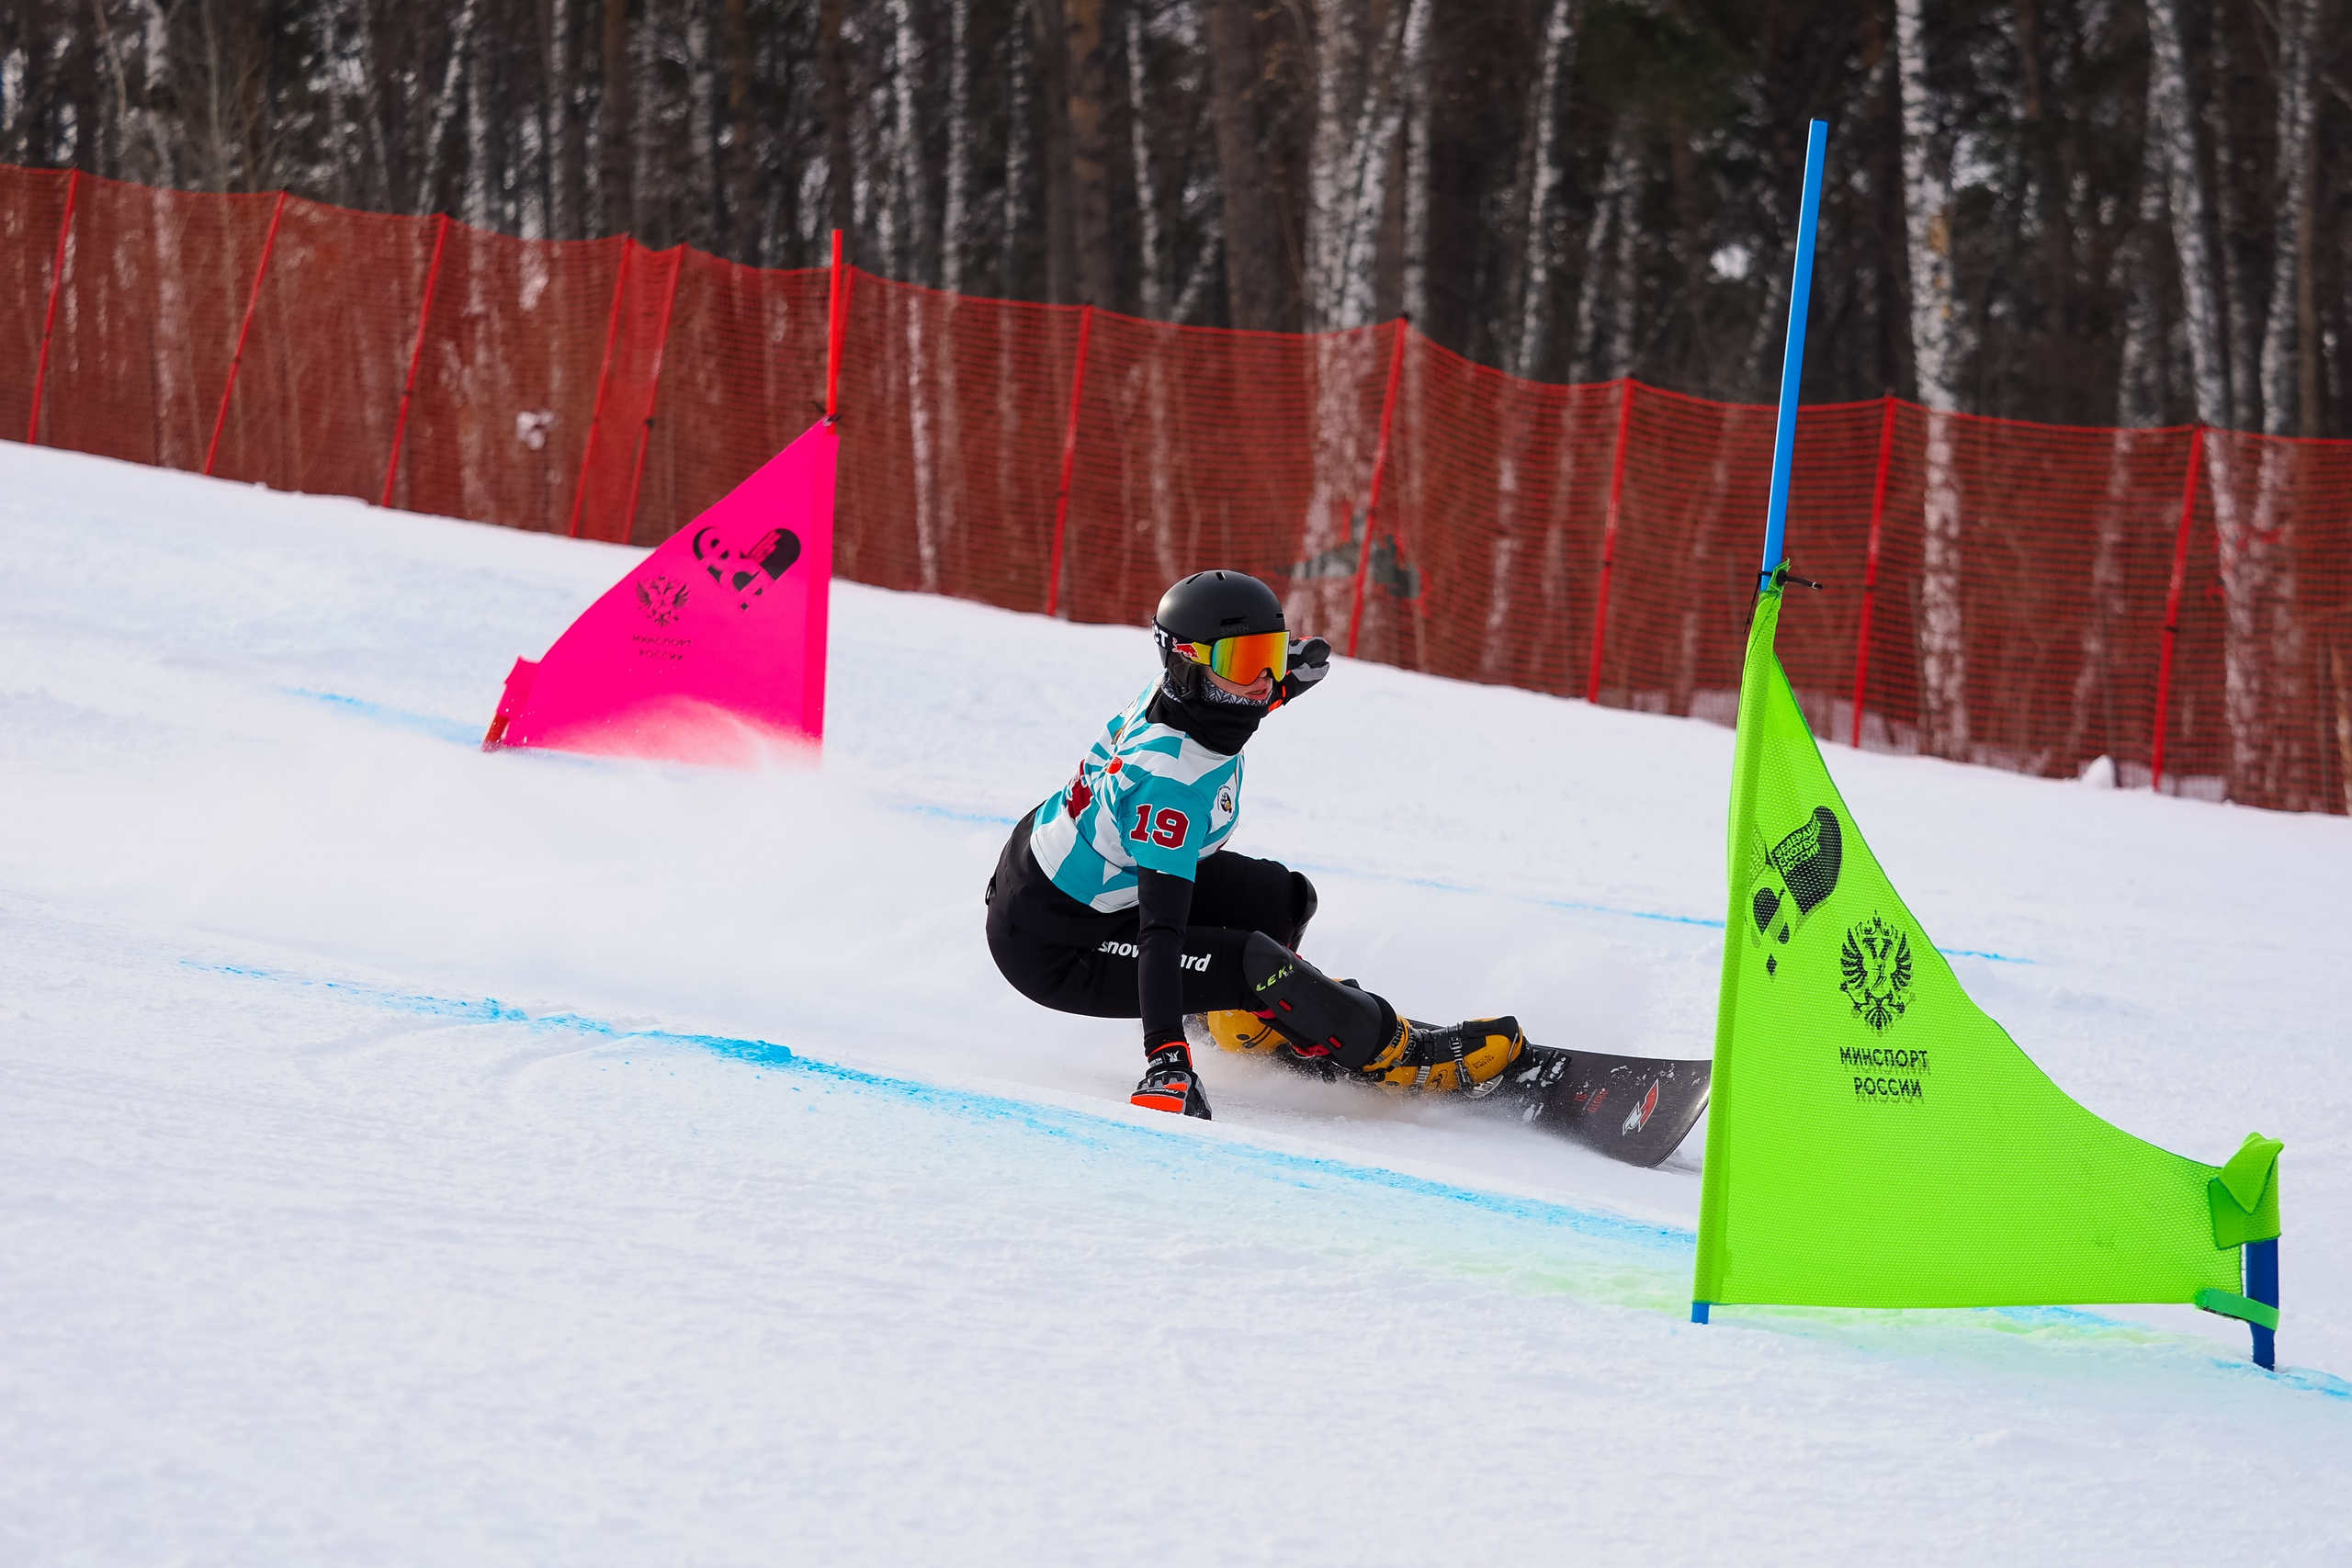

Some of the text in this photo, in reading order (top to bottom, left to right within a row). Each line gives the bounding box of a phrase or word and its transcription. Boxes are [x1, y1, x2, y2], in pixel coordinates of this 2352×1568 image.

[1220, 625, 1250, 636] SMITH
[1129, 804, 1191, 851] 19
[1782, 841, 1821, 876] РОССИИ
[1839, 1046, 1928, 1068] МИНСПОРТ
[1853, 1077, 1923, 1097] РОССИИ
